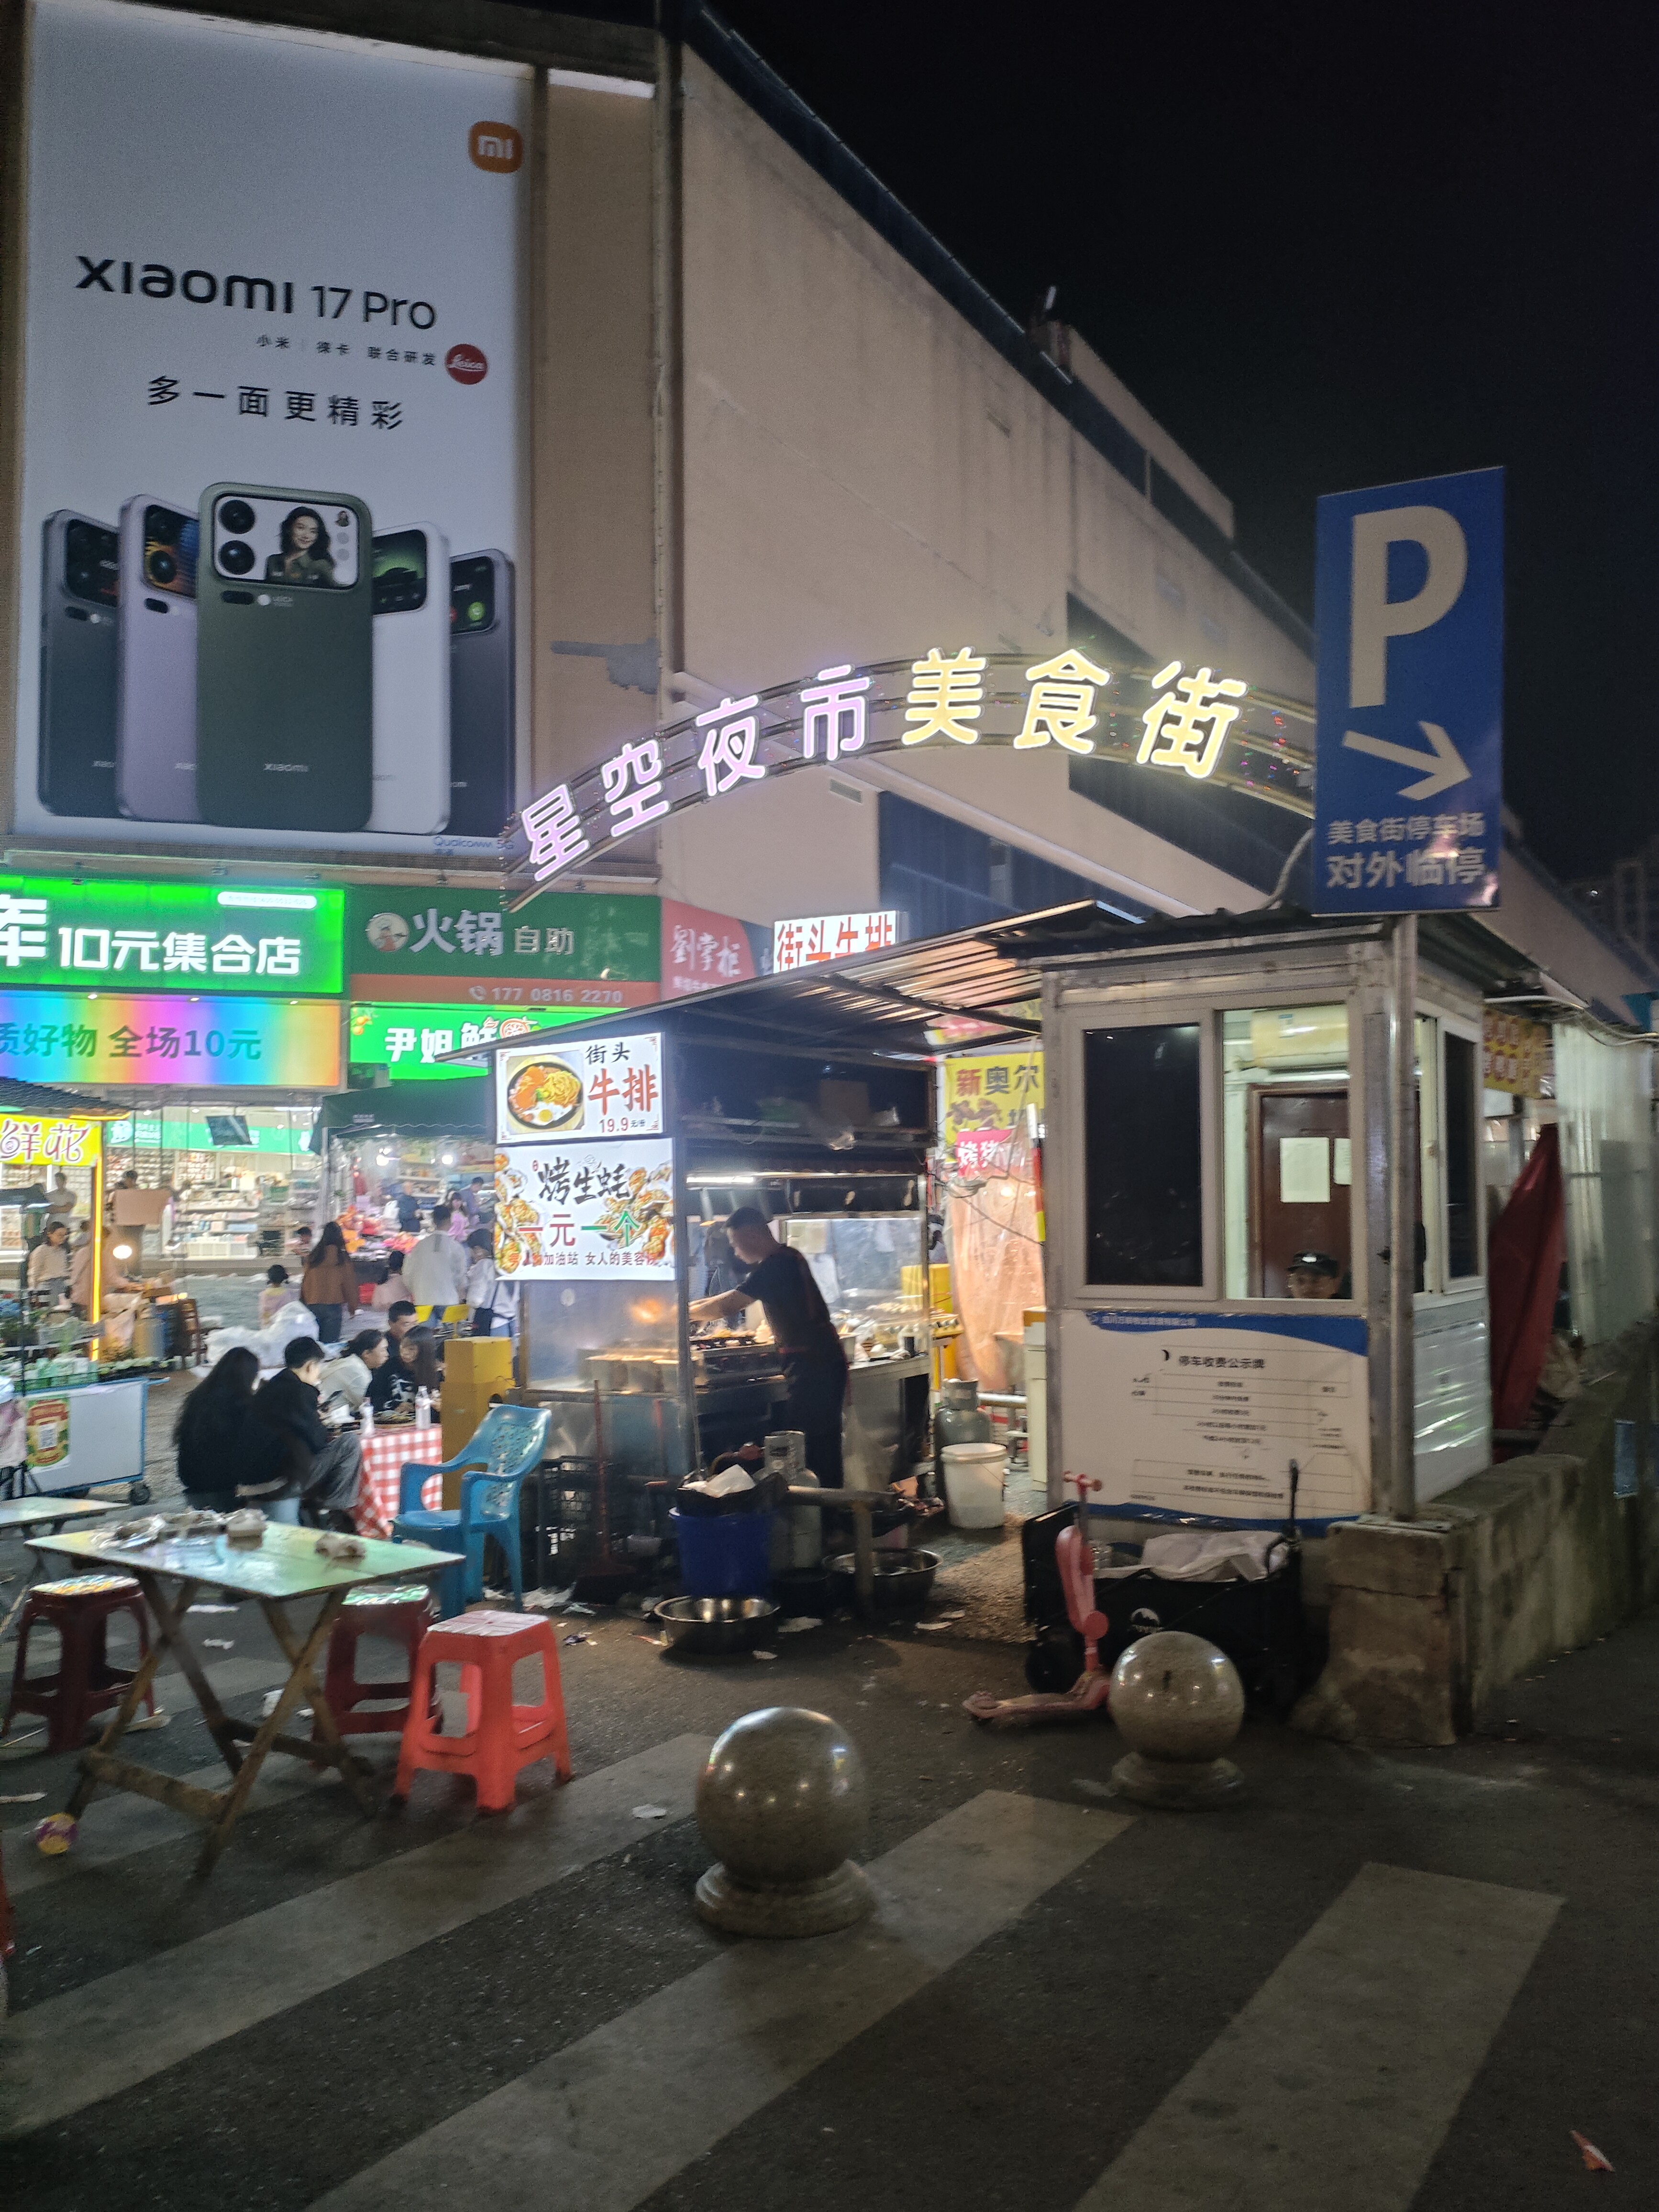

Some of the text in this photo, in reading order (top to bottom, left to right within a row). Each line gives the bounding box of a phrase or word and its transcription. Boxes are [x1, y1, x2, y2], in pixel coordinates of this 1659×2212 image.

[311, 286, 352, 318] 17
[362, 291, 436, 330] Pro
[256, 335, 289, 347] 小米
[368, 346, 435, 366] 联合研发
[148, 376, 404, 430] 多一面更精彩
[1350, 505, 1468, 708] P
[521, 646, 1249, 882] 星空夜市美食街
[1327, 812, 1485, 845] 美食街停车场
[1327, 846, 1485, 889] 对外临停
[409, 908, 575, 956] 火锅 自助
[491, 987, 622, 1004] 177 0816 2270
[109, 1025, 262, 1060] 全场10元
[586, 1042, 630, 1065] 街头
[588, 1064, 659, 1115] 牛排
[0, 1119, 90, 1161] 鲜花
[538, 1157, 630, 1205] 烤生蚝
[519, 1211, 640, 1248] 一元一个
